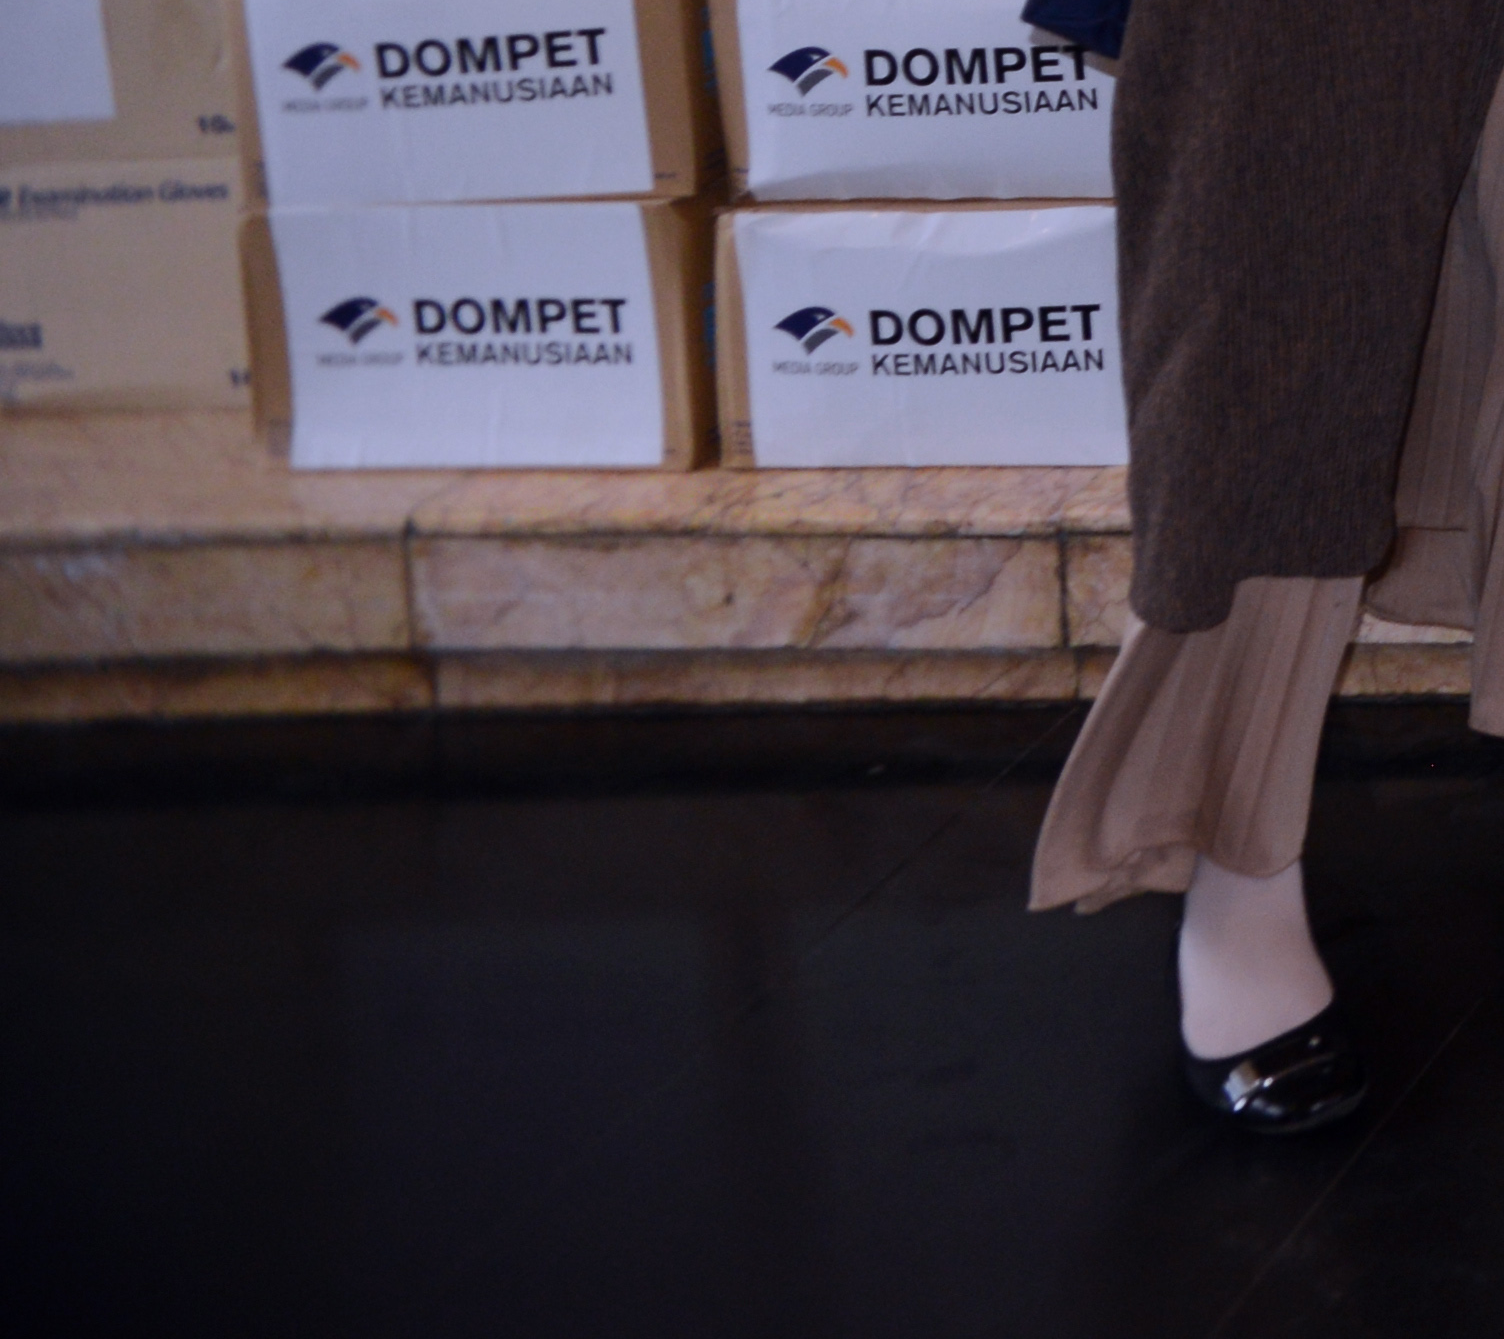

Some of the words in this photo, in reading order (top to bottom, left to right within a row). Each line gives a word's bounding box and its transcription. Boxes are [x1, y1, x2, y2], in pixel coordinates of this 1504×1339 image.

[375, 28, 606, 77] DOMPET
[865, 45, 1085, 86] DOMPET
[381, 75, 612, 108] KEMANUSIAAN
[867, 89, 1098, 116] KEMANUSIAAN
[413, 298, 625, 335] DOMPET
[870, 304, 1100, 346] DOMPET
[417, 342, 632, 365] KEMANUSIAAN
[873, 349, 1104, 376] KEMANUSIAAN
